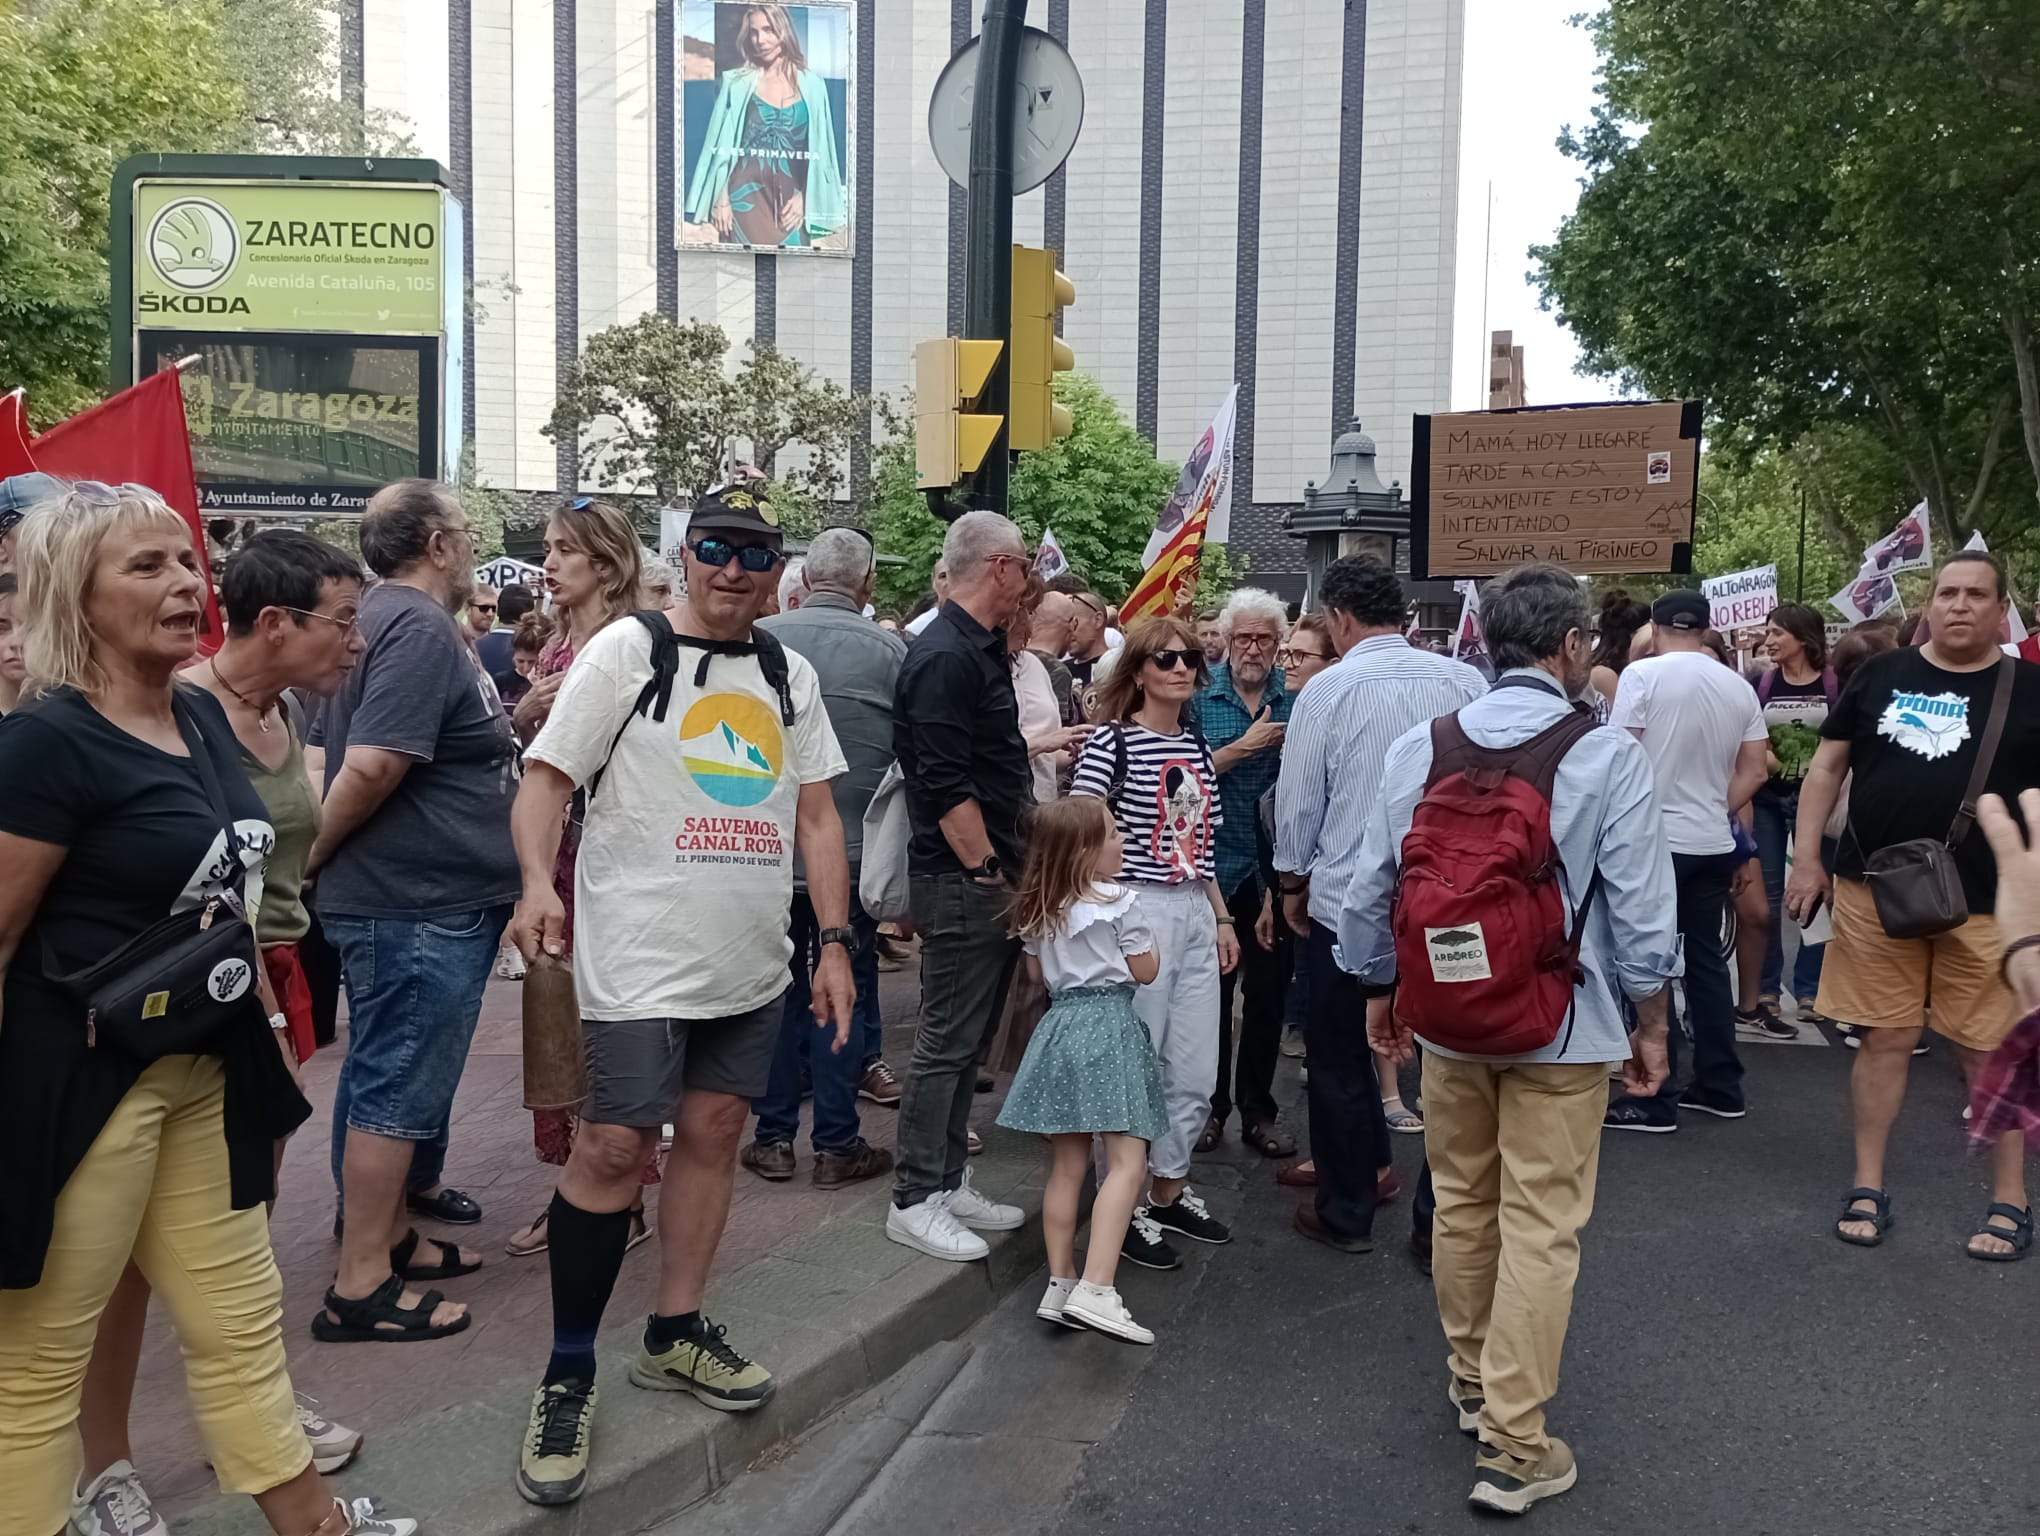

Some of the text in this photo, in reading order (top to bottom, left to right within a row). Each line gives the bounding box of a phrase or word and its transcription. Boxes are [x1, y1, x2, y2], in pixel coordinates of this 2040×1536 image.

[750, 148, 820, 161] PRIMAVERA
[246, 221, 435, 249] ZARATECNO
[249, 253, 430, 267] Concesionario Oficial Škoda en Zaragoza
[246, 274, 435, 292] Avenida Cataluña, 105
[138, 291, 251, 314] ŠKODA
[228, 382, 419, 433] Zaragoza
[1448, 426, 1656, 456] MAMÁ HOY LLEGARÉ
[1444, 462, 1510, 484] TARDE
[1521, 464, 1535, 478] A
[206, 491, 305, 507] Ayuntamiento
[309, 493, 327, 507] de
[1442, 487, 1645, 510] SOLAMENTE ESTOY
[1442, 514, 1570, 534] INTENTANDO
[1454, 539, 1538, 562] SALVAR
[1548, 544, 1571, 561] AL
[1709, 595, 1777, 627] NO REBLA
[1896, 696, 1965, 719] PUMA
[684, 817, 779, 837] SALVEMOS
[675, 835, 783, 855] CANAL ROYA
[675, 855, 781, 867] EL PIRINEO NO SE VENDE
[1434, 949, 1483, 962] ARBOREO
